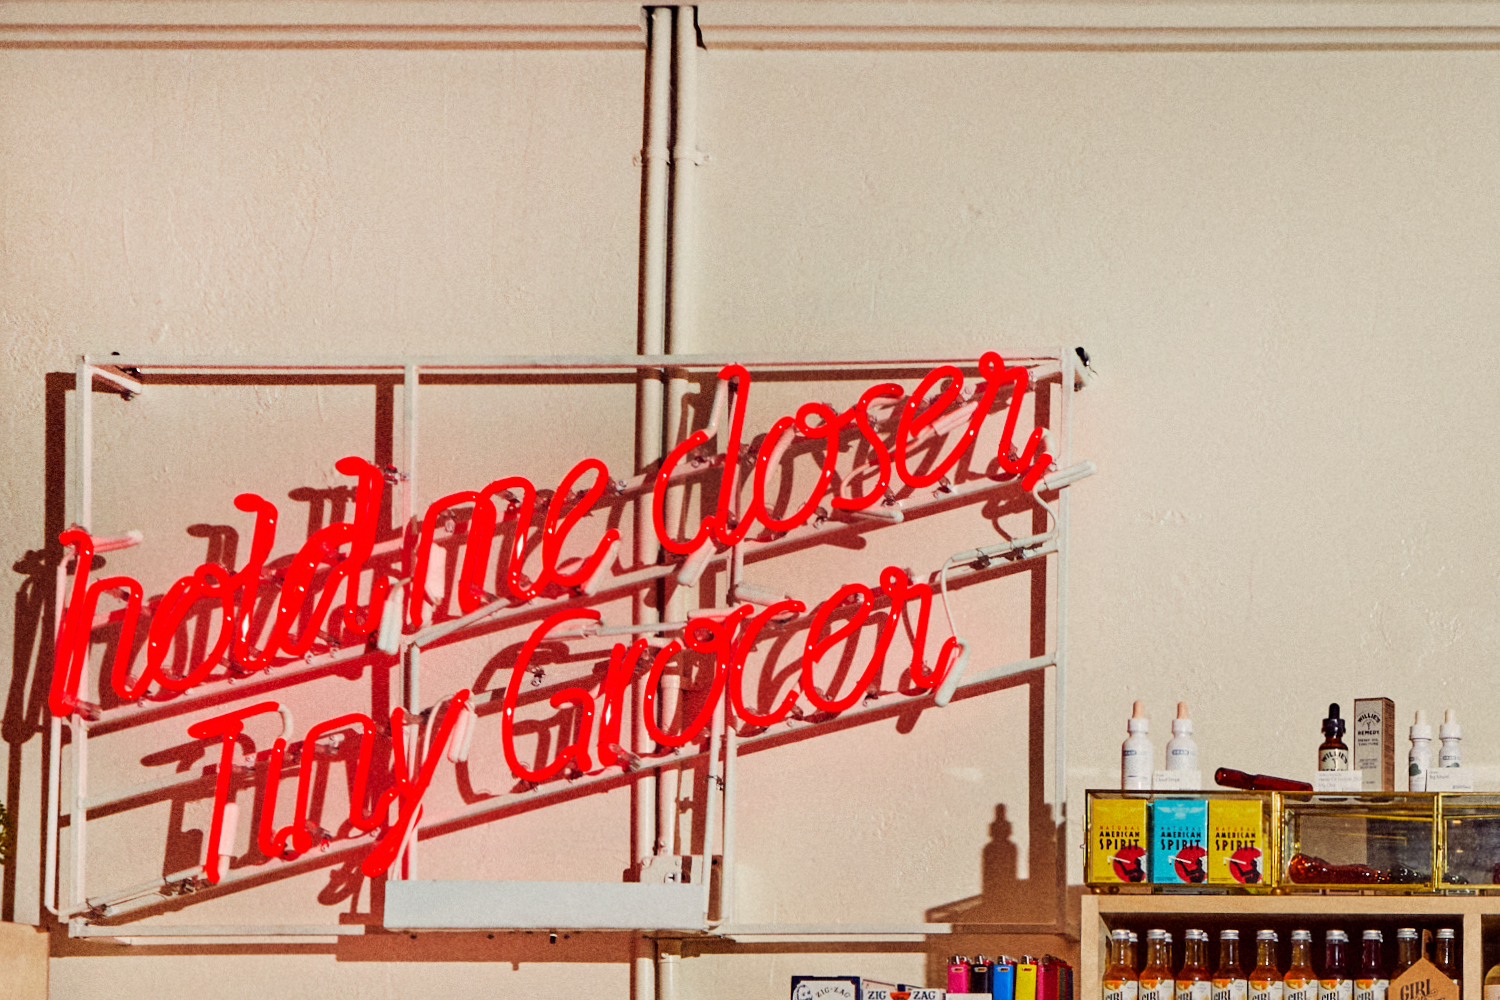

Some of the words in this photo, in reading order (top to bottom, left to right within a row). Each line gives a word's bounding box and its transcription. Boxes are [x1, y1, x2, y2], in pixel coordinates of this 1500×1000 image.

[49, 457, 388, 719] hold
[407, 459, 623, 628] me
[187, 688, 472, 884] Tiny
[501, 567, 963, 785] Grocer
[1099, 838, 1140, 851] SPIRIT
[1159, 839, 1201, 851] SPIRIT
[1215, 839, 1255, 852] SPIRIT
[815, 986, 851, 998] ZIG-ZAG
[868, 990, 887, 1000] ZIG
[913, 990, 936, 1000] ZAG
